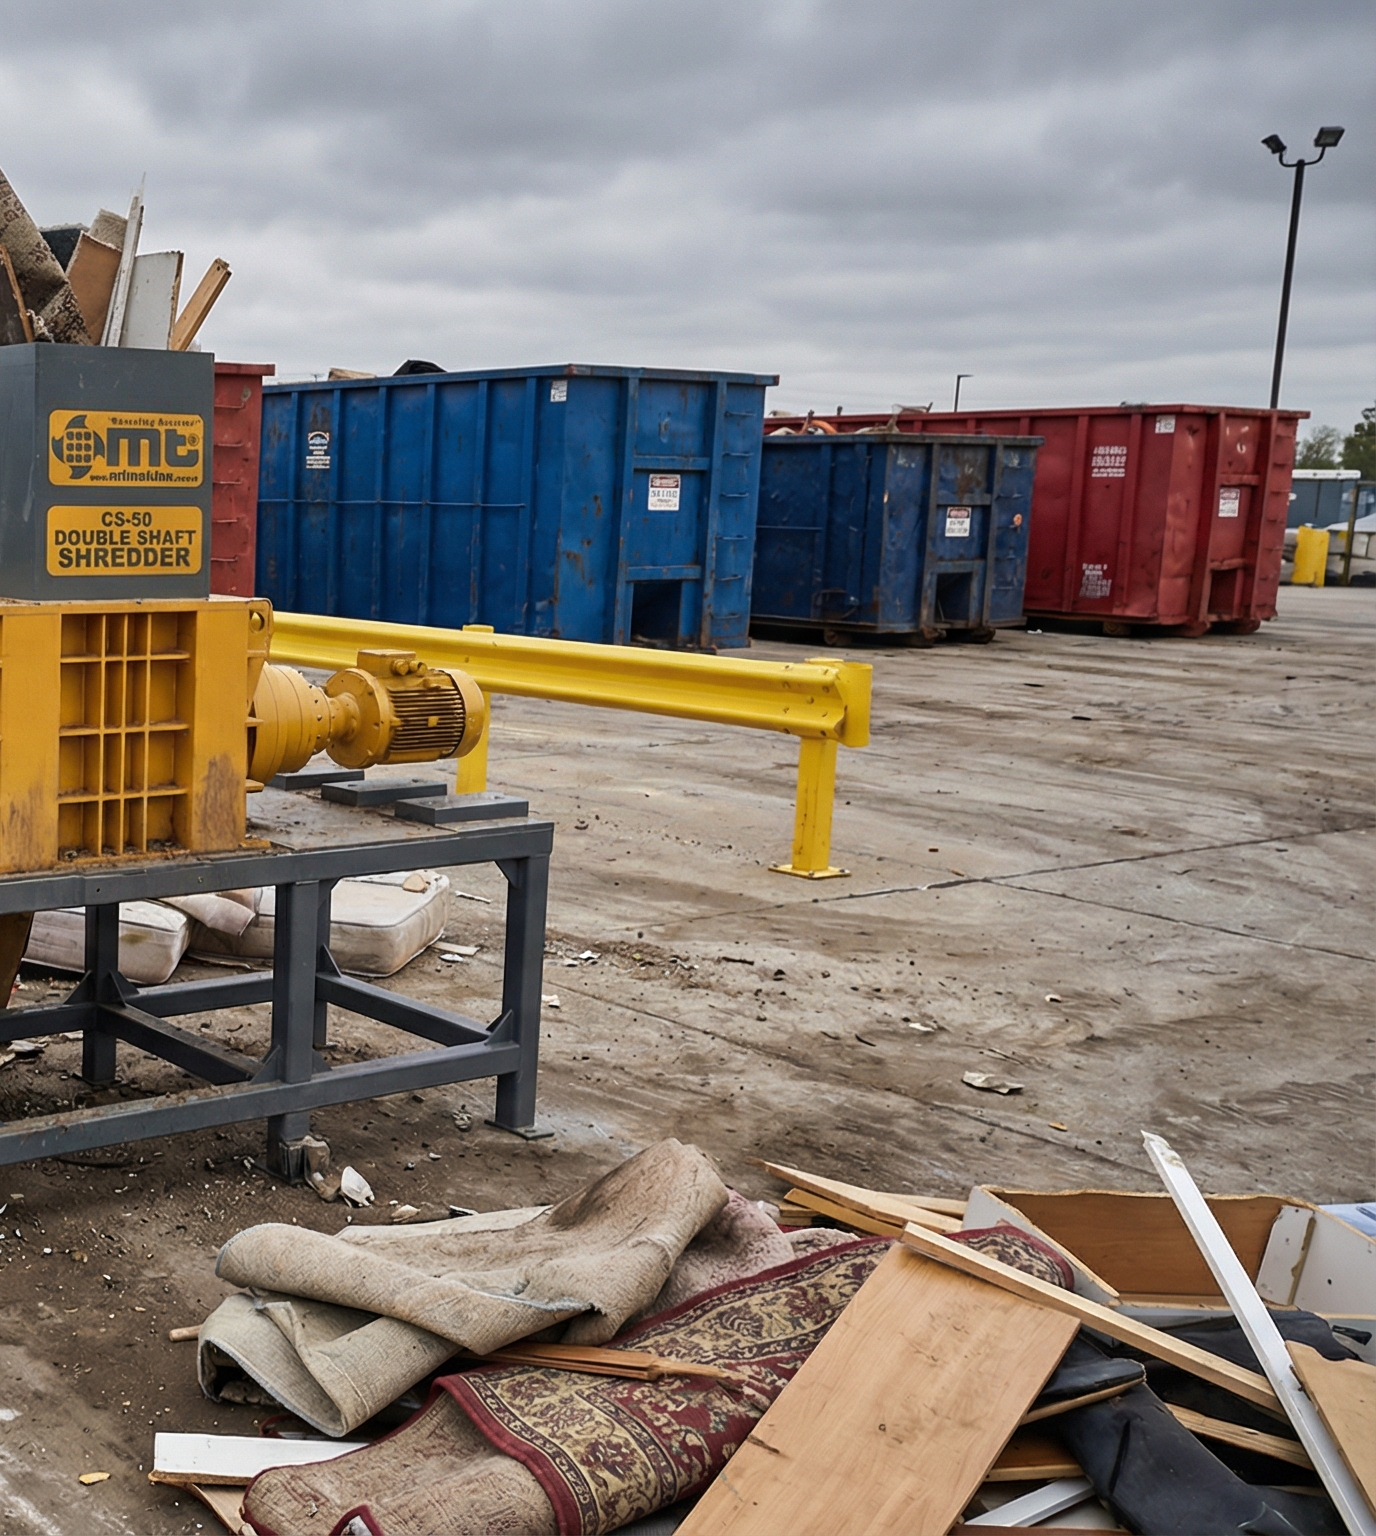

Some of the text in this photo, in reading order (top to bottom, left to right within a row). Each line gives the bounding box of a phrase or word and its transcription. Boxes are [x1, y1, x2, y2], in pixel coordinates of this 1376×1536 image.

[101, 511, 152, 527] CS-50
[54, 529, 196, 545] DOUBLE SHAFT
[58, 547, 191, 568] SHREDDER
